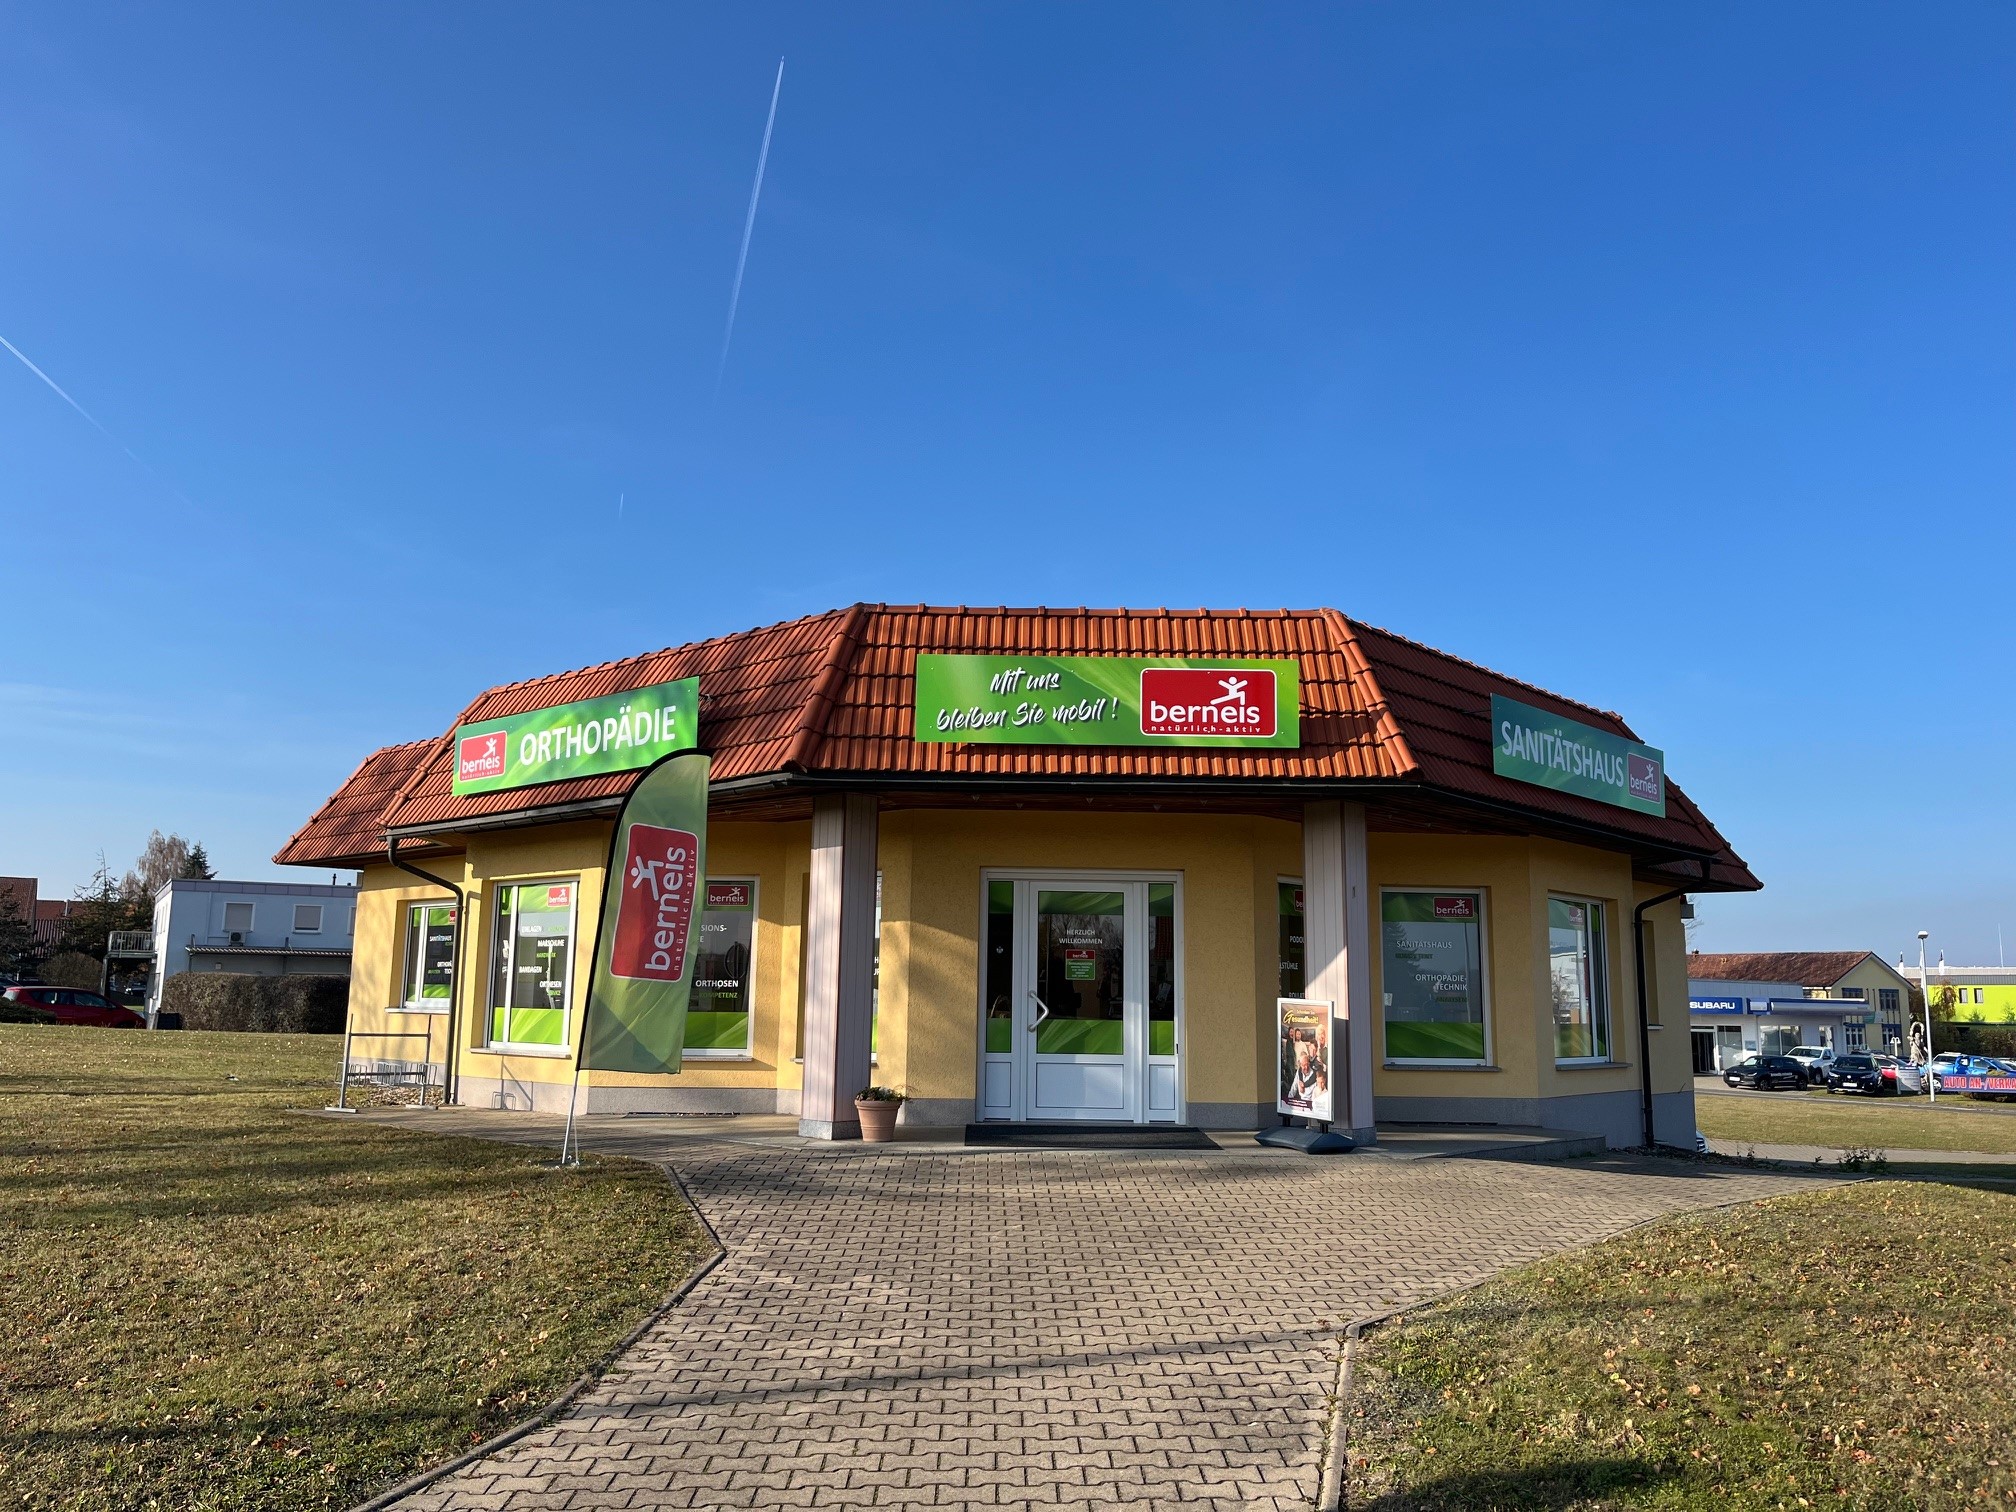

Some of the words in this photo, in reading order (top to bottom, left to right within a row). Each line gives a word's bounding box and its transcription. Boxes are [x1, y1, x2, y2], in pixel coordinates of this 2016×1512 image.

[990, 667, 1026, 695] Mit
[1026, 672, 1060, 690] uns
[937, 706, 1007, 731] bleiben
[1012, 702, 1047, 726] Sie
[1052, 698, 1106, 724] mobil
[1150, 700, 1260, 724] berneis
[519, 705, 676, 766] ORTHOPÄDIE
[1151, 725, 1261, 733] natürlich-aktiv
[1501, 720, 1624, 788] SANITÄTSHAUS
[462, 756, 500, 774] berneis
[1630, 773, 1657, 795] berneis
[710, 894, 744, 902] berneis
[645, 846, 686, 971] berneis
[674, 849, 695, 971] natürlich-aktiv
[1436, 906, 1470, 914] berneis
[695, 980, 739, 989] ORTHOSEN
[1436, 983, 1468, 991] TECHNIK
[1689, 1001, 1736, 1009] SUBARU
[1944, 1076, 1967, 1088] AUTO
